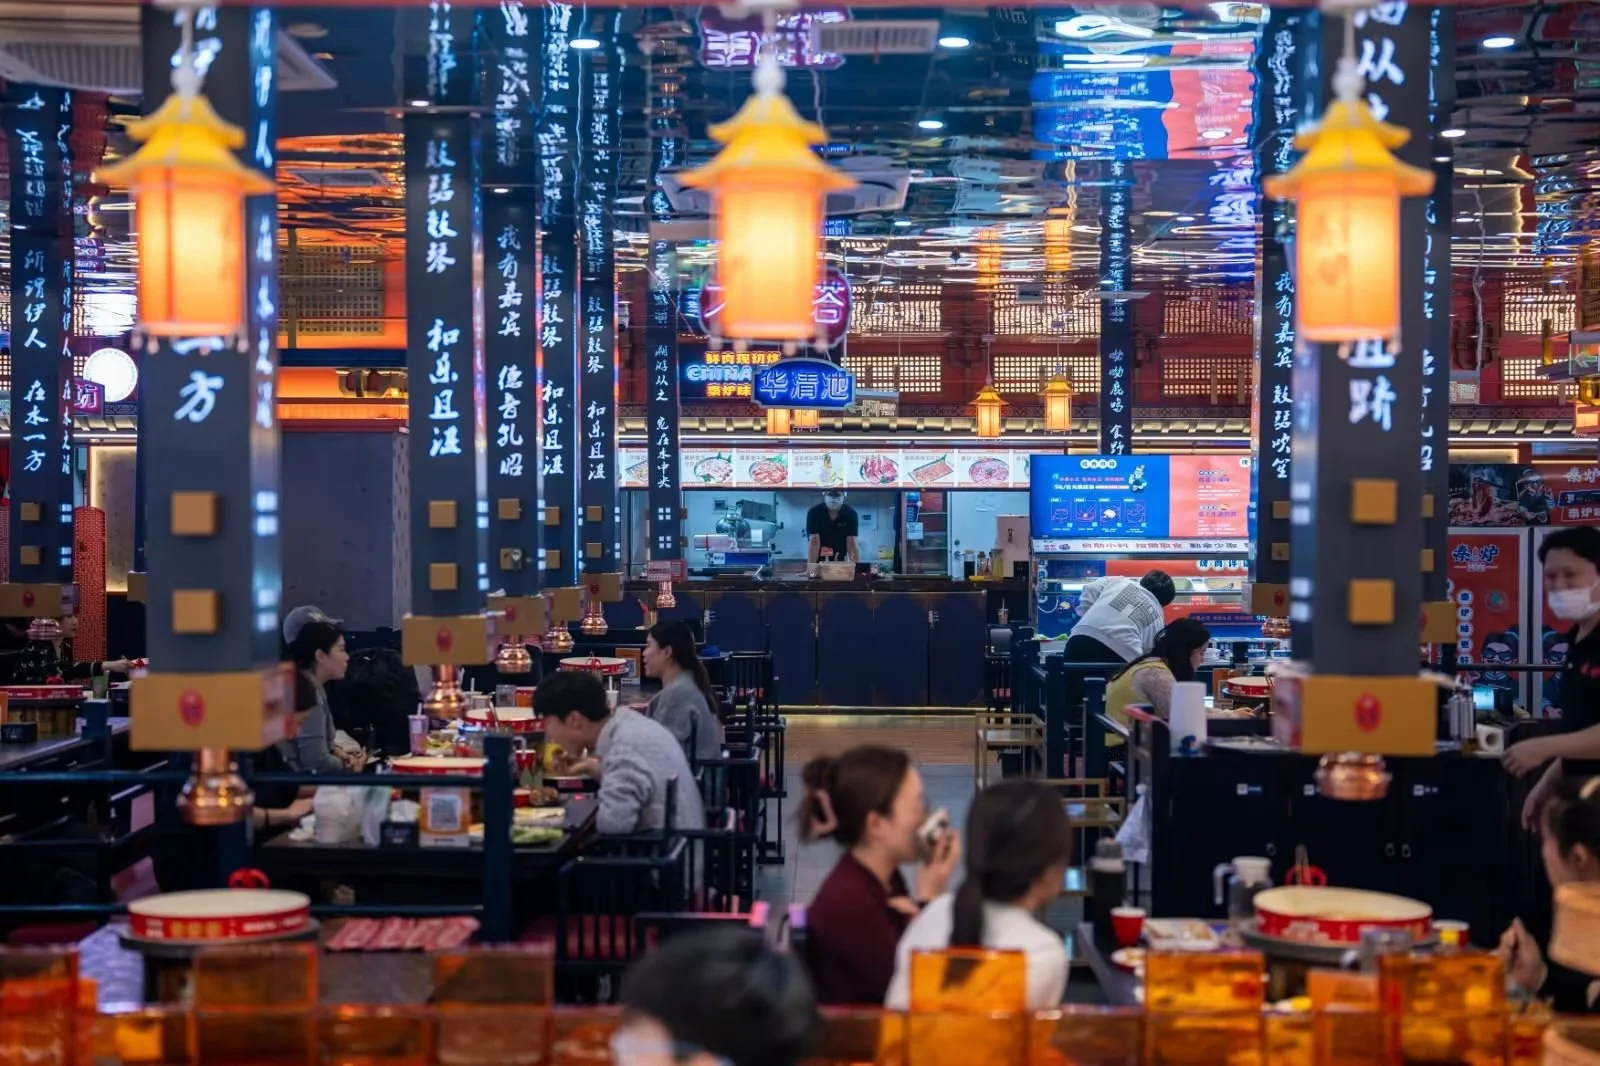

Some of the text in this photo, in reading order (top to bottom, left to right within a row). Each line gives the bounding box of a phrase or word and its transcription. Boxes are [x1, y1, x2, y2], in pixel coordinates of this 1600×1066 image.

[23, 250, 48, 472] 所谓伊人 在水一方
[497, 224, 524, 477] 我有嘉宾 德音孔昭
[686, 365, 752, 381] CHINA
[760, 370, 849, 399] 华清池
[1108, 349, 1125, 414] 呦呦鹿鸣
[1271, 271, 1295, 479] 我有嘉宾 鼓瑟吹笙
[542, 380, 564, 476] 和乐且湛
[588, 400, 606, 481] 和乐且湛
[656, 416, 672, 489] 宛在水中央
